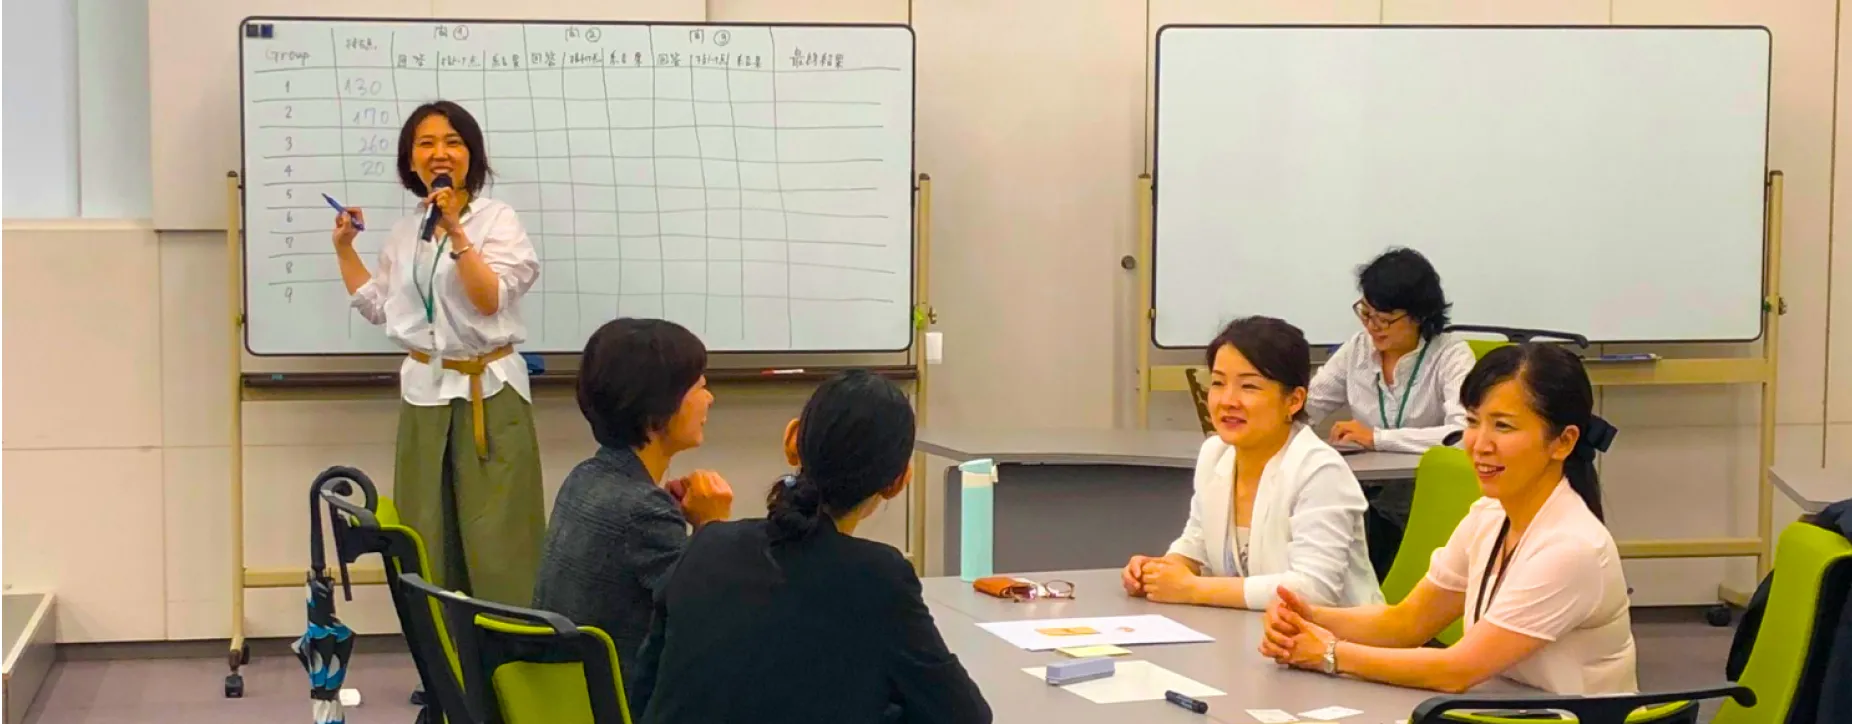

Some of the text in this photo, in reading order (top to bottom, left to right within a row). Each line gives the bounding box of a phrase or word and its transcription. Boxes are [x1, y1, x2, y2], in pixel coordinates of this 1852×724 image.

[264, 45, 311, 66] Group
[284, 79, 382, 97] 1 130
[284, 105, 390, 125] 2 170
[284, 134, 389, 155] 3 260
[283, 160, 386, 178] 4 20
[285, 188, 292, 200] 5
[286, 210, 293, 223] 6
[285, 236, 294, 249] 7
[285, 261, 293, 274] 8
[284, 287, 293, 303] 9
